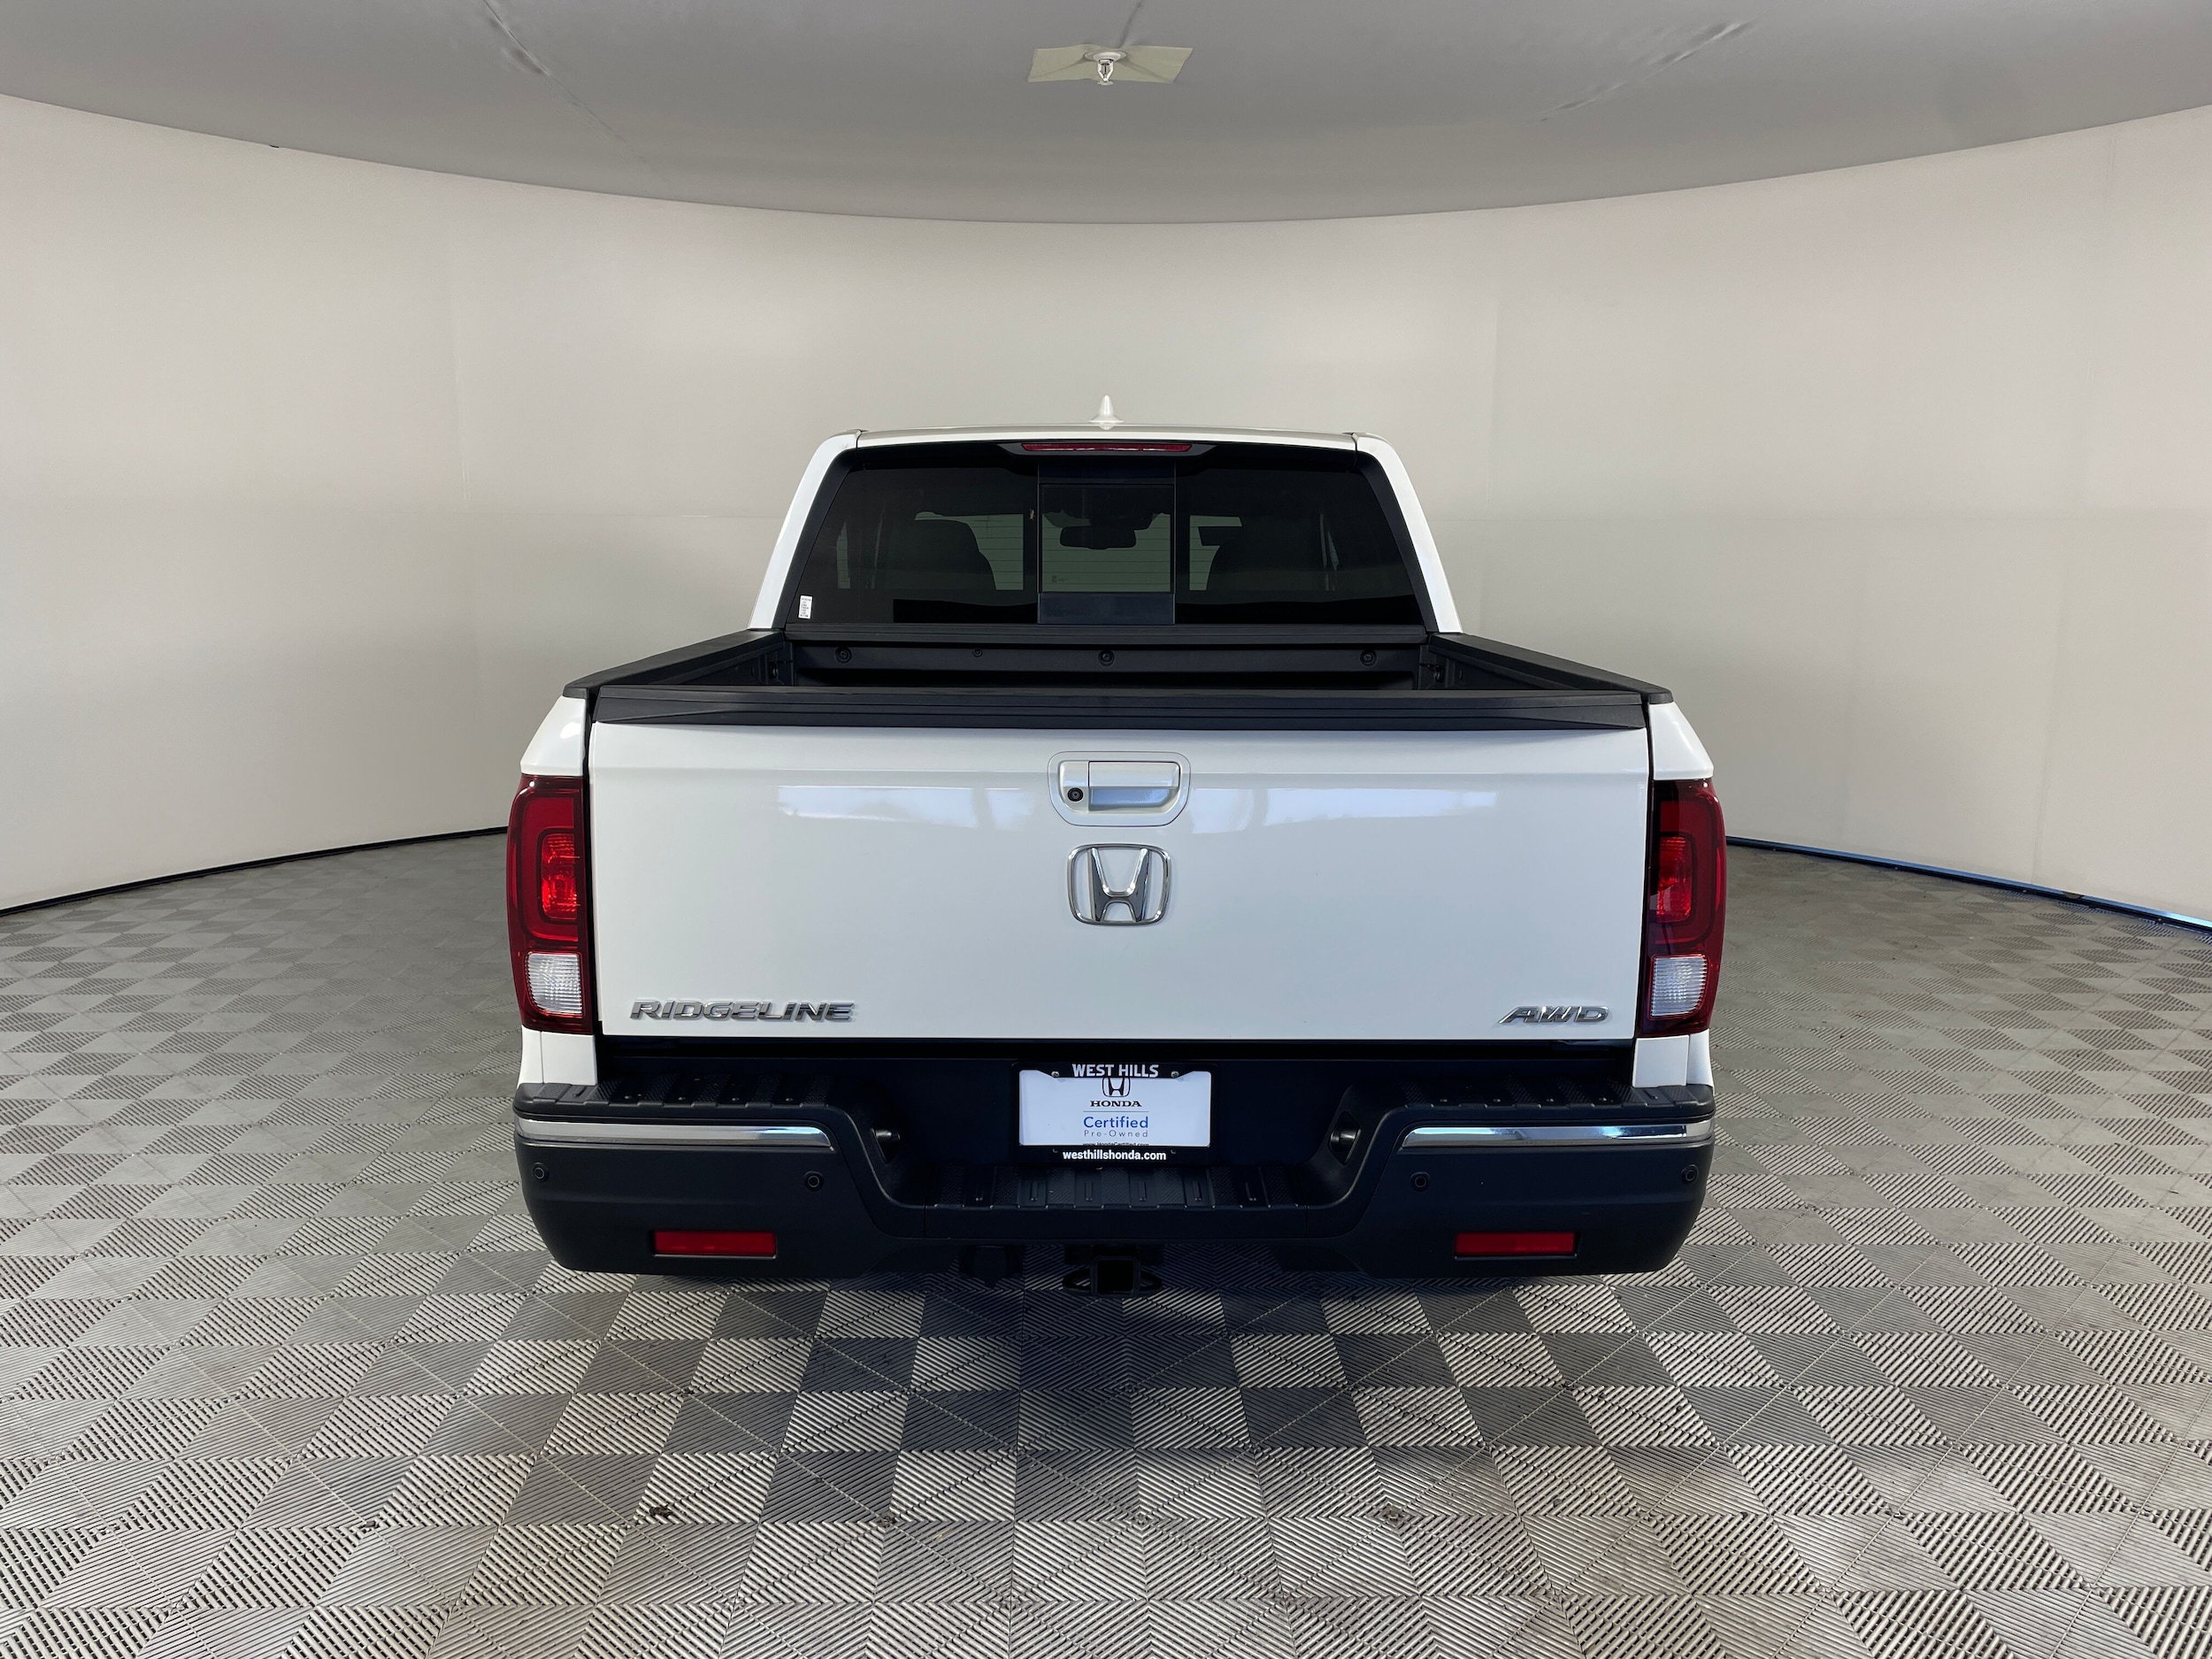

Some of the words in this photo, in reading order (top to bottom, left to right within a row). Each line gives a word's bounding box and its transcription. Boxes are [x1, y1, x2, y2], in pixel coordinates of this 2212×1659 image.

[629, 1000, 855, 1021] RIDGELINE
[1498, 1006, 1609, 1024] AWD
[1072, 1064, 1114, 1077] WEST
[1118, 1064, 1159, 1078] HILLS
[1083, 1117, 1148, 1128] Certified
[1084, 1129, 1148, 1138] Pre-Owned
[1063, 1149, 1167, 1160] westhillshonda.com
